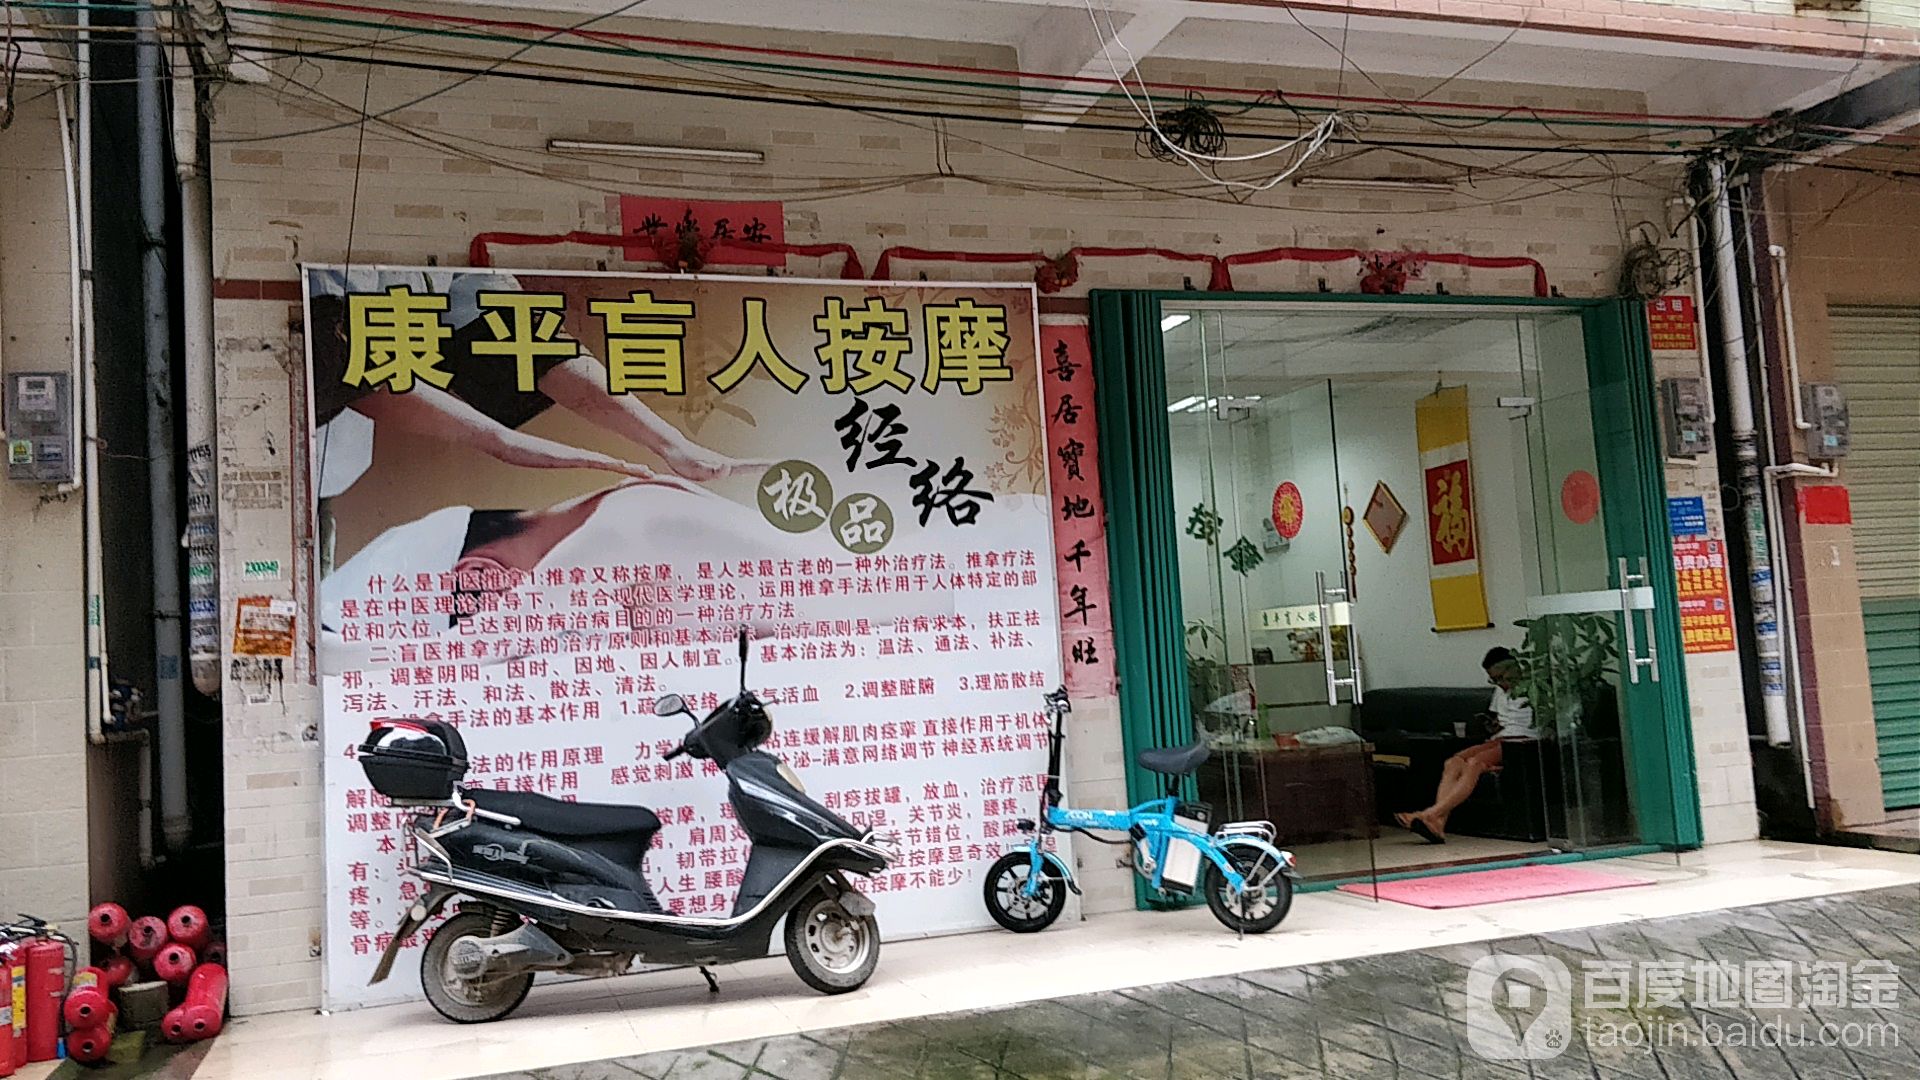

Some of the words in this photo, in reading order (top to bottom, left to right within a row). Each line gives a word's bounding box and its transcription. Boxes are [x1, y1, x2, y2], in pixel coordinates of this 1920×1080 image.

[342, 286, 1014, 396] 康平盲人按摩
[762, 466, 890, 549] 极品
[834, 398, 995, 528] 经络
